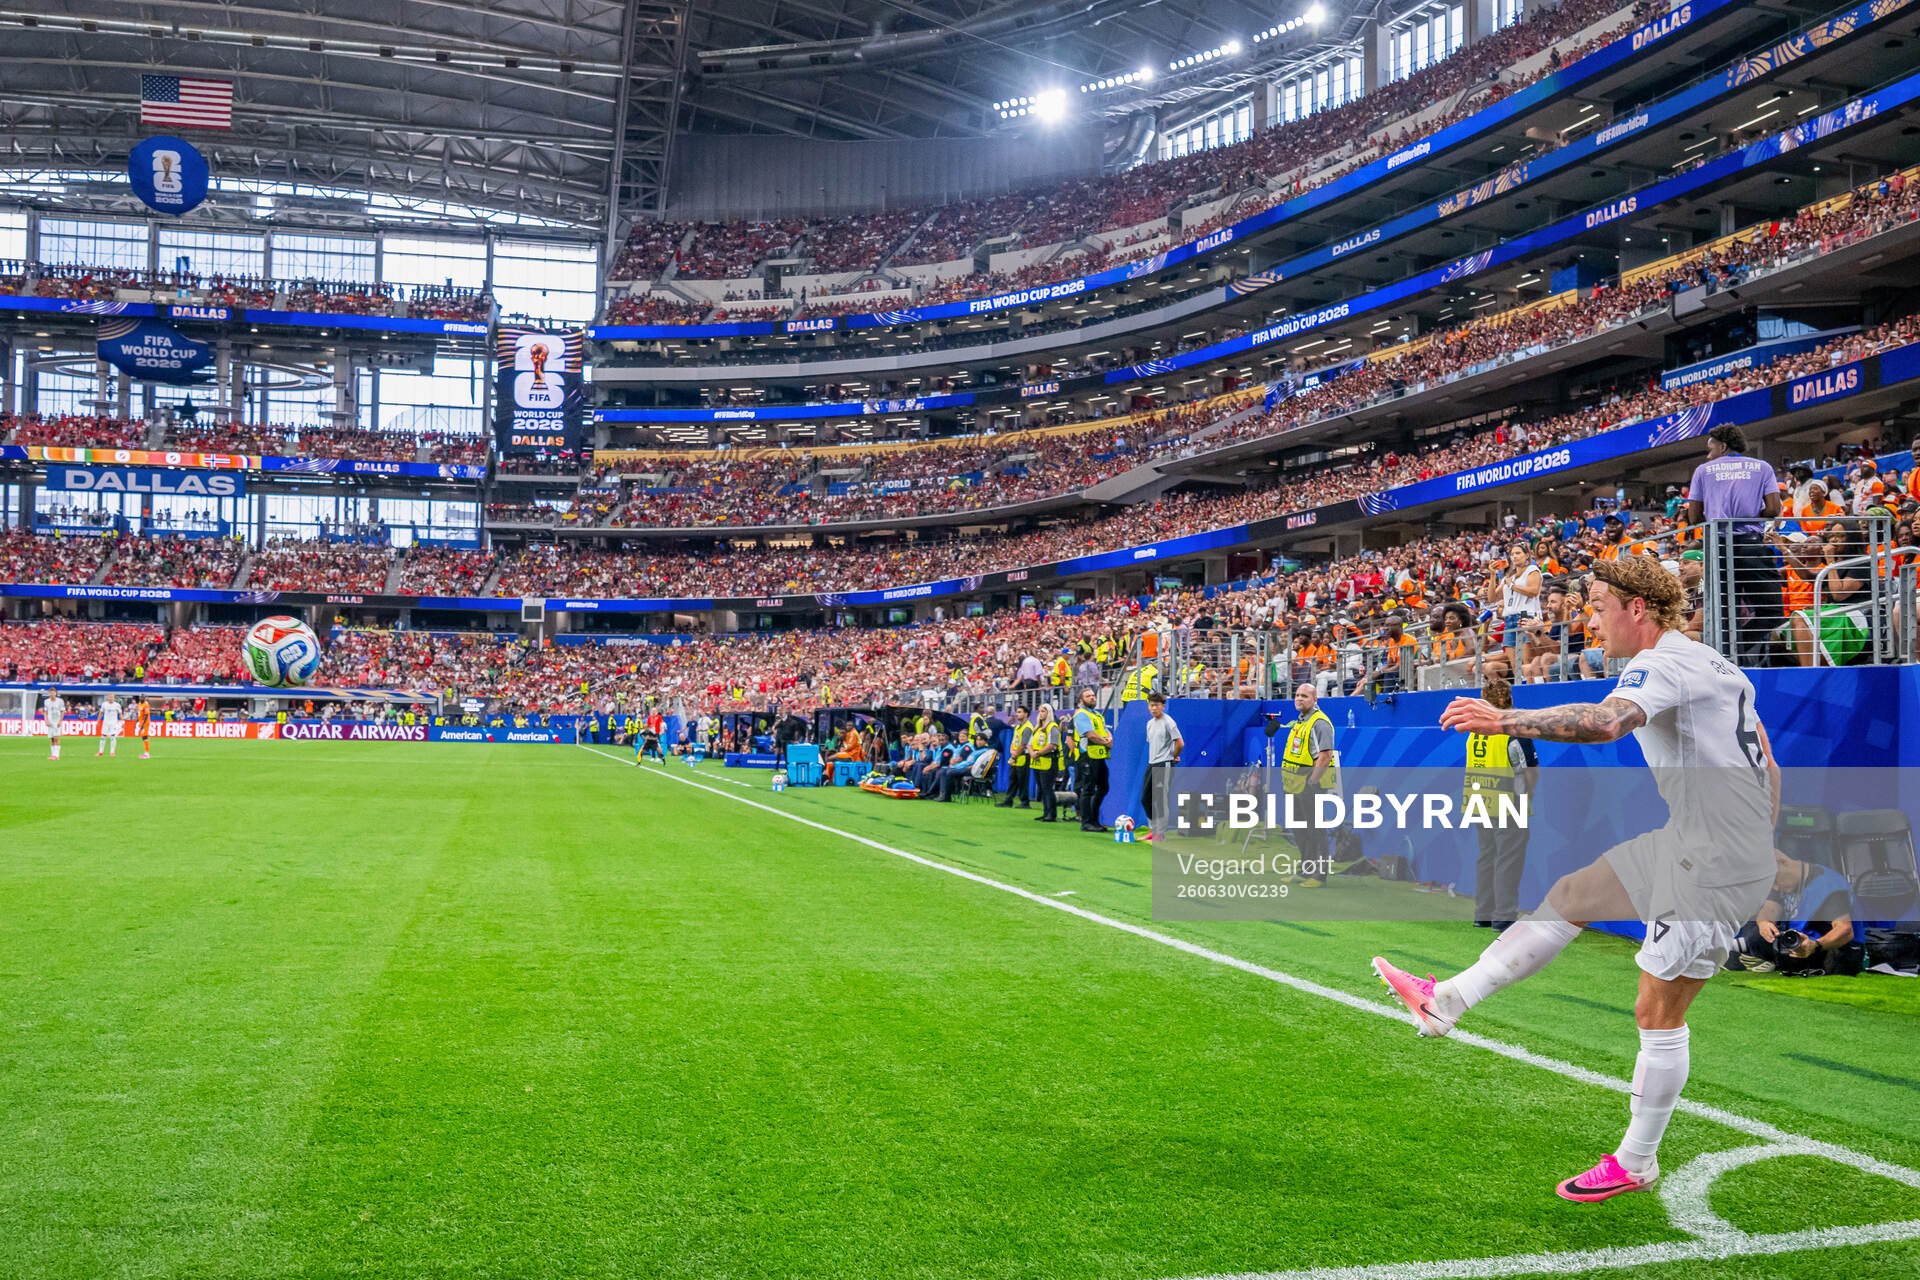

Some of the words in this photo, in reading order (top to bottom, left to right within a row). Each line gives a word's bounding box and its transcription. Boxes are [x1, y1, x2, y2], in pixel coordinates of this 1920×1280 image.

[1632, 5, 1692, 51] DALLAS
[1596, 113, 1648, 146] #FIFAWorldCup
[1586, 196, 1637, 229] DALLAS
[1196, 228, 1233, 253] DALLAS
[1332, 229, 1381, 257] DALLAS
[969, 299, 993, 313] FIFA
[993, 292, 1029, 310] WORLD
[1029, 288, 1051, 302] CUP
[1051, 280, 1086, 298] 2026
[172, 306, 227, 320] DALLAS
[787, 319, 833, 332] DALLAS
[1252, 330, 1270, 346] FIFA
[1269, 321, 1300, 341] WORLD
[1300, 314, 1319, 331] CUP
[1318, 303, 1350, 324] 2026
[144, 335, 173, 348] FIFA
[120, 345, 169, 359] WORLD
[170, 348, 197, 360] CUP
[135, 357, 182, 369] 2026
[1664, 376, 1681, 390] FIFA
[1681, 369, 1708, 385] WORLD
[1708, 364, 1724, 377] CUP
[1724, 356, 1752, 373] 2026
[1020, 382, 1060, 397] DALLAS
[1792, 368, 1858, 404] DALLAS
[528, 393, 551, 403] FIFA
[514, 410, 545, 420] WORLD
[545, 411, 564, 420] CUP
[513, 418, 564, 431] 2026
[512, 435, 565, 447] DALLAS
[354, 462, 400, 473] DALLAS
[1456, 475, 1476, 491] FIFA
[1477, 465, 1512, 486] WORLD
[1512, 459, 1533, 477] CUP
[1533, 448, 1571, 472] 2026
[1705, 462, 1742, 473] STADIUM
[1744, 461, 1761, 471] FAN
[65, 469, 236, 496] DALLAS
[1715, 470, 1751, 481] SERVICES
[1286, 511, 1317, 529] DALLAS
[67, 588, 87, 596] FIFA
[87, 588, 120, 597] WORLD
[120, 589, 139, 598] CUP
[139, 590, 171, 598] 2026
[1, 720, 21, 735] THE
[62, 720, 97, 736] DEPOT
[165, 722, 193, 737] FREE
[195, 722, 248, 738] DELIVERY
[281, 724, 343, 741] QATAR
[350, 724, 425, 741] AIRWAYS
[440, 730, 482, 741] American
[507, 731, 549, 742] American
[1464, 775, 1500, 789] ECURITY
